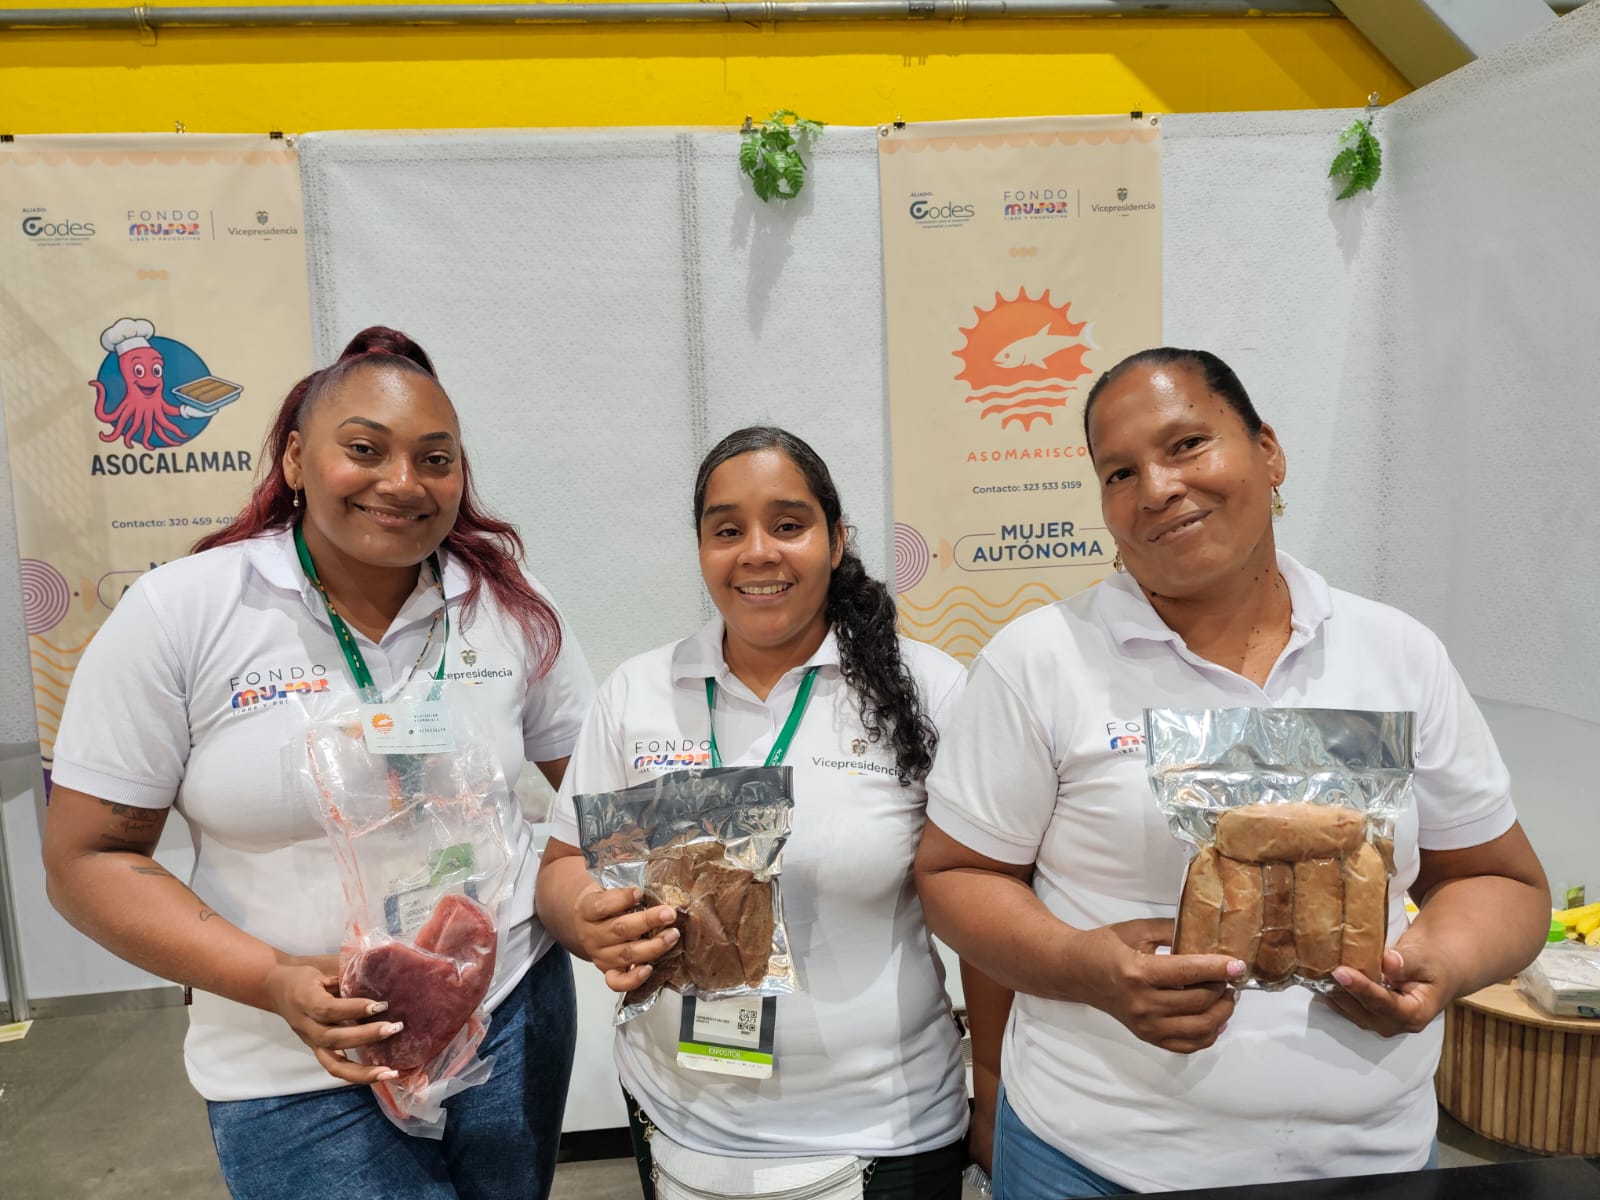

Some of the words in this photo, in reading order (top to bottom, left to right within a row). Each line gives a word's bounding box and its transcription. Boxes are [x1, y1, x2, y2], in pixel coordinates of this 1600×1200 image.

[1003, 189, 1068, 201] FONDO
[127, 210, 200, 221] FONDO
[910, 200, 975, 220] Codes
[1091, 201, 1156, 214] Vicepresidencia
[22, 216, 96, 237] Codes
[227, 226, 298, 237] Vicepresidencia
[967, 446, 1087, 463] ASOMARISCO
[91, 450, 252, 476] ASOCALAMAR
[972, 484, 1021, 494] Contacto:
[1023, 483, 1039, 492] 323
[1042, 482, 1059, 490] 533
[1061, 480, 1082, 489] 5159
[111, 518, 166, 529] Contacto:
[169, 517, 188, 527] 320
[192, 517, 212, 526] 459
[216, 516, 237, 524] 401
[1001, 521, 1075, 541] MUJER
[972, 540, 1103, 563] AUTÓNOMA
[229, 664, 326, 692] FONDO
[428, 667, 513, 681] Vcepresidencia
[635, 739, 712, 754] FONDO
[812, 756, 903, 777] Vicepresidencia
